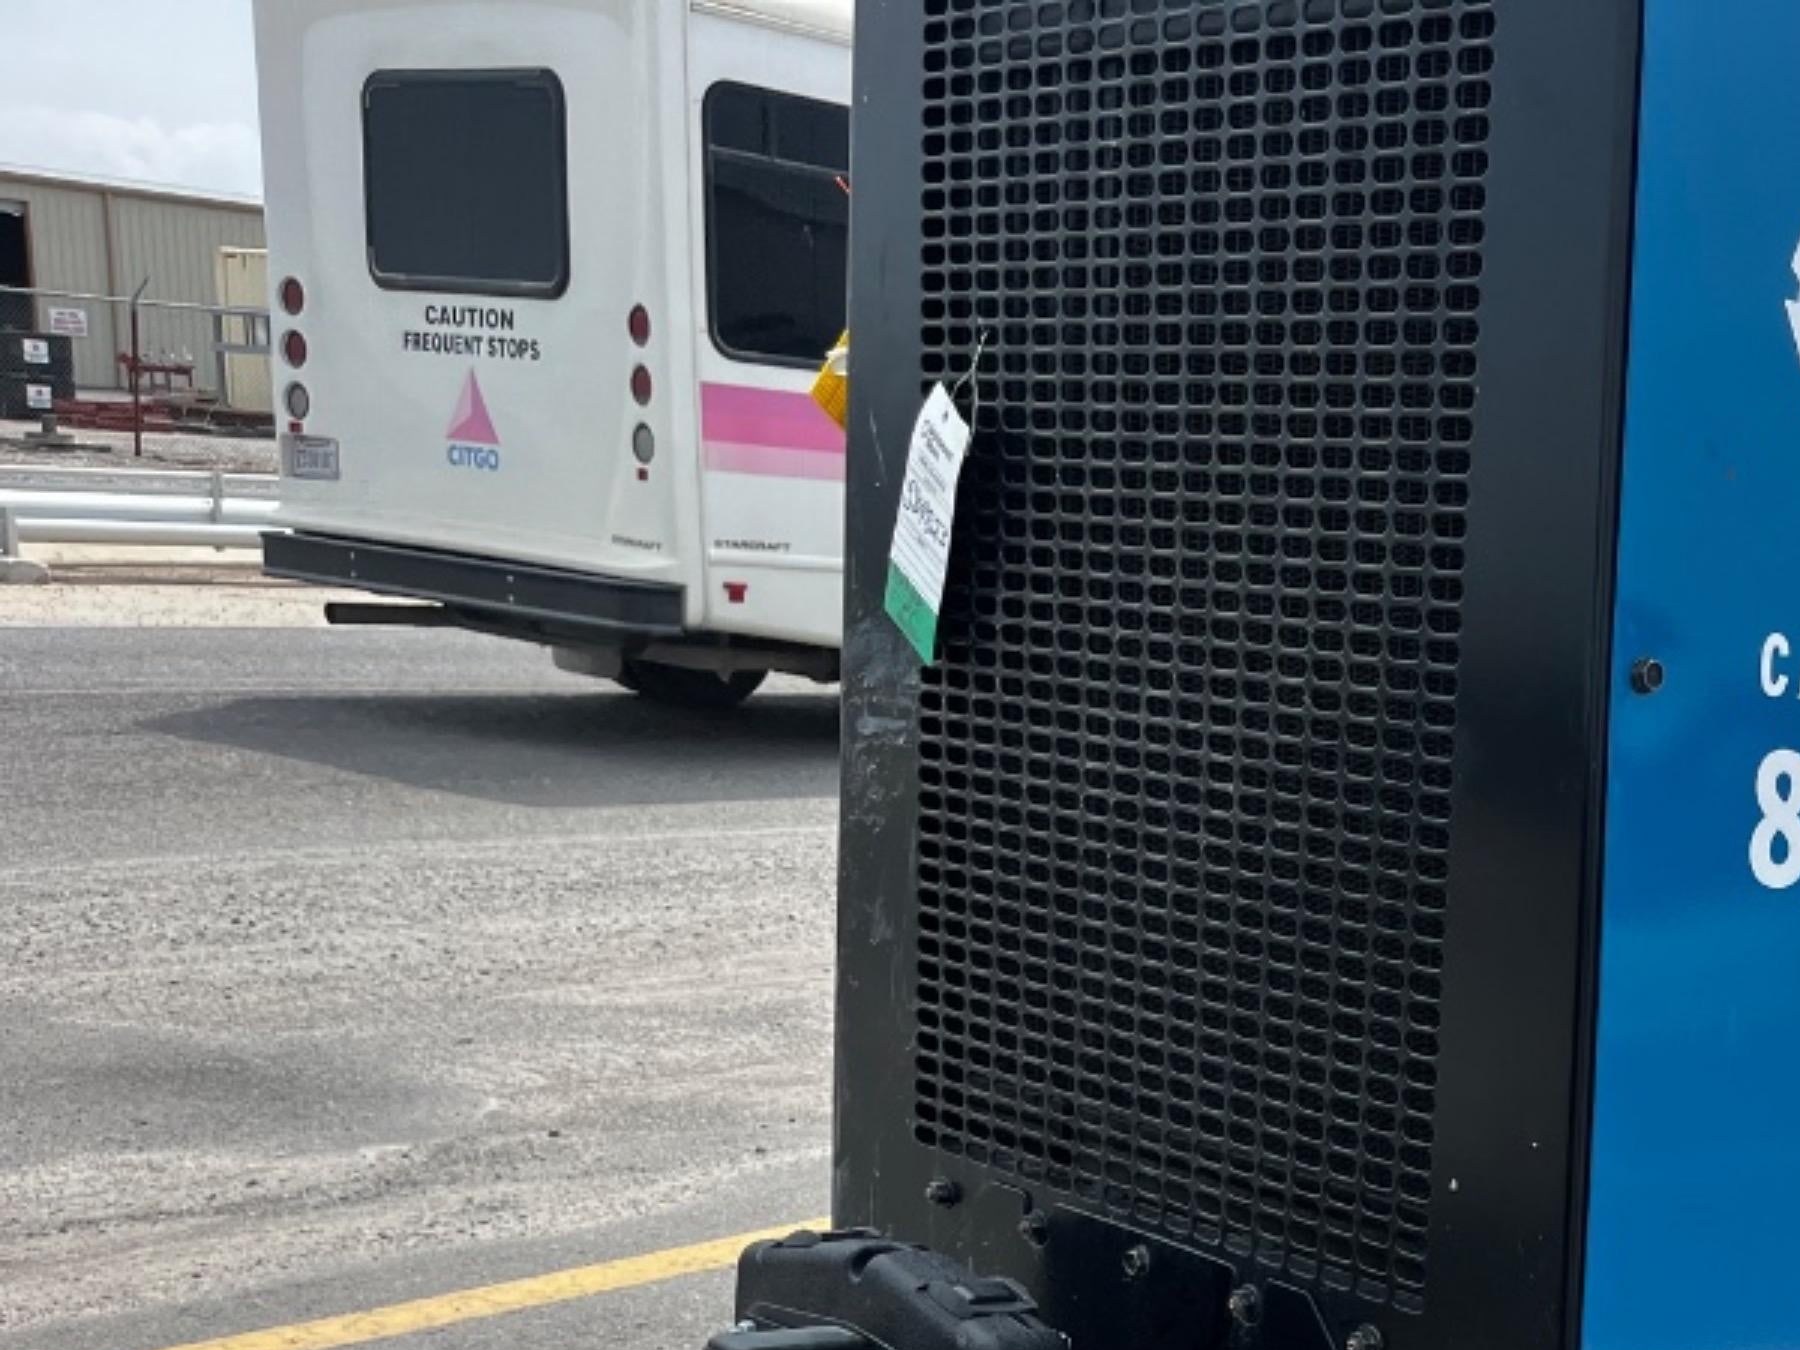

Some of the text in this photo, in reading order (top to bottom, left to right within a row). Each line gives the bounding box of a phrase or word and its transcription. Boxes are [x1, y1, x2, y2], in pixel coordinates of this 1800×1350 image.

[424, 305, 514, 330] CAUTION
[403, 330, 541, 361] FREQUENT STOPS
[447, 444, 499, 471] CITGO
